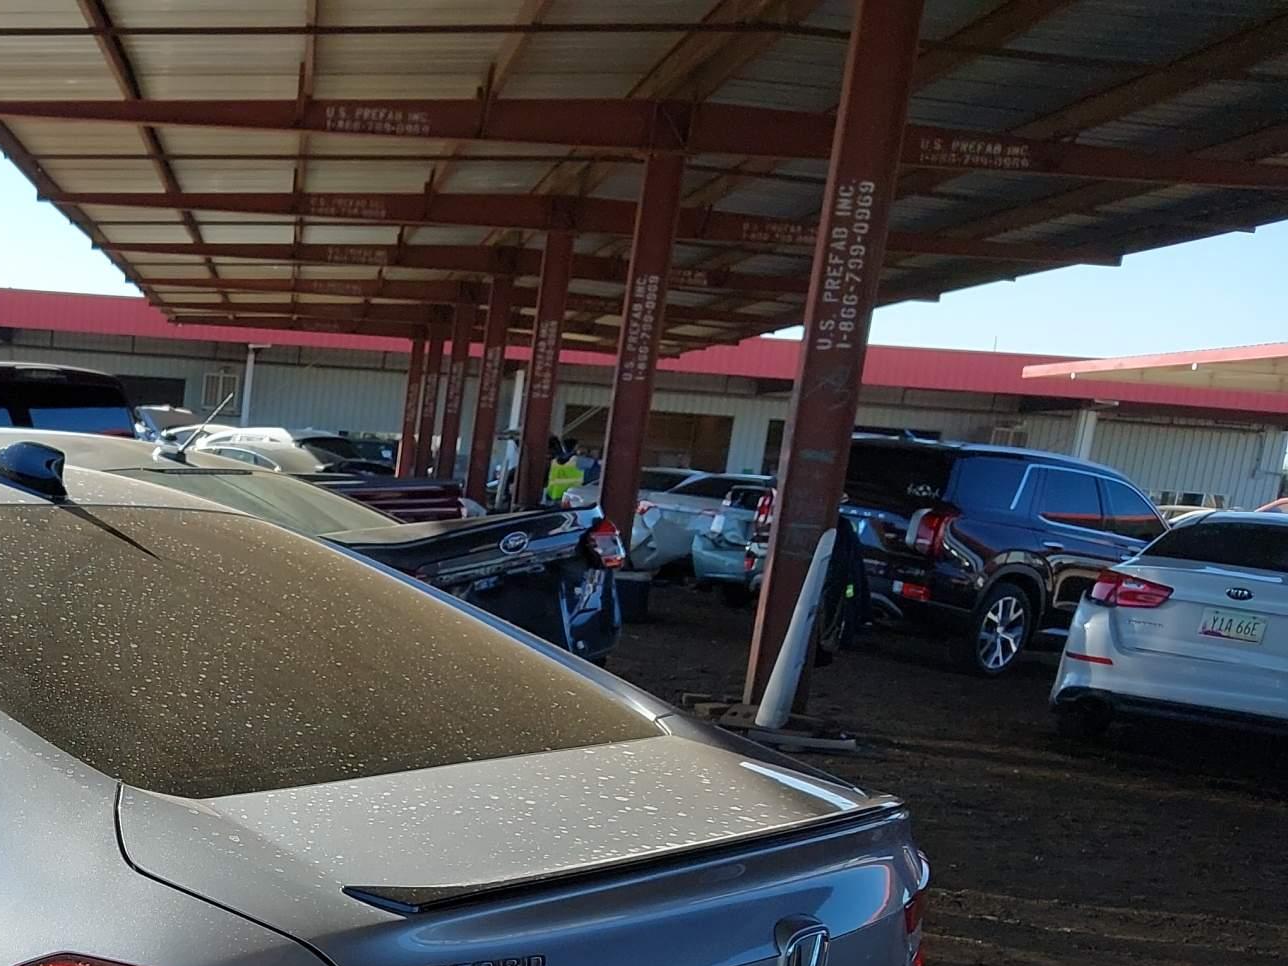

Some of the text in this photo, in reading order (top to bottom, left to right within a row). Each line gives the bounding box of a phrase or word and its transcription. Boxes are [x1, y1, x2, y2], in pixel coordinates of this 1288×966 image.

[816, 179, 857, 350] U.S. PREFAB INC.
[835, 180, 876, 349] 1-866-799-0969
[1235, 620, 1261, 637] 66E
